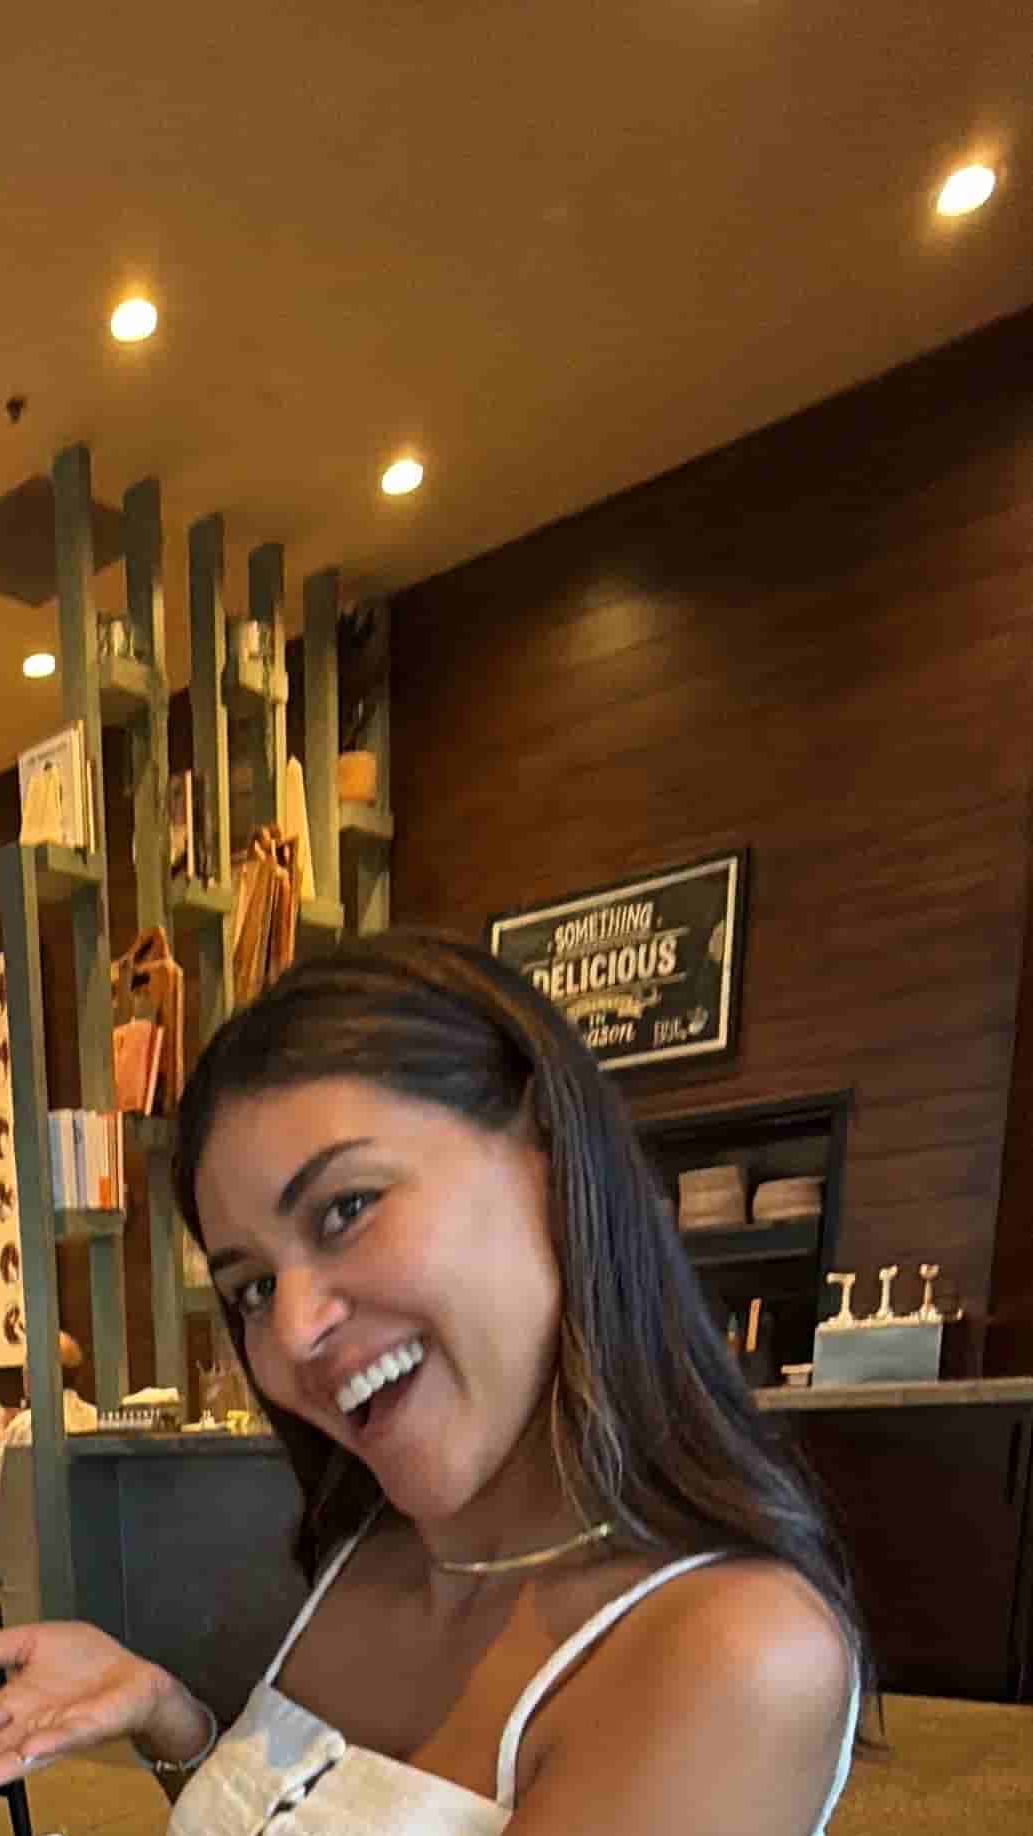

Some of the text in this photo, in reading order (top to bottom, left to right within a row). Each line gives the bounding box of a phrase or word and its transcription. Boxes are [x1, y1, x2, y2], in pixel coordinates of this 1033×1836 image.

[554, 902, 654, 952] SOMETHING
[533, 935, 677, 999] DELICIOUS
[585, 1022, 635, 1050] ason
